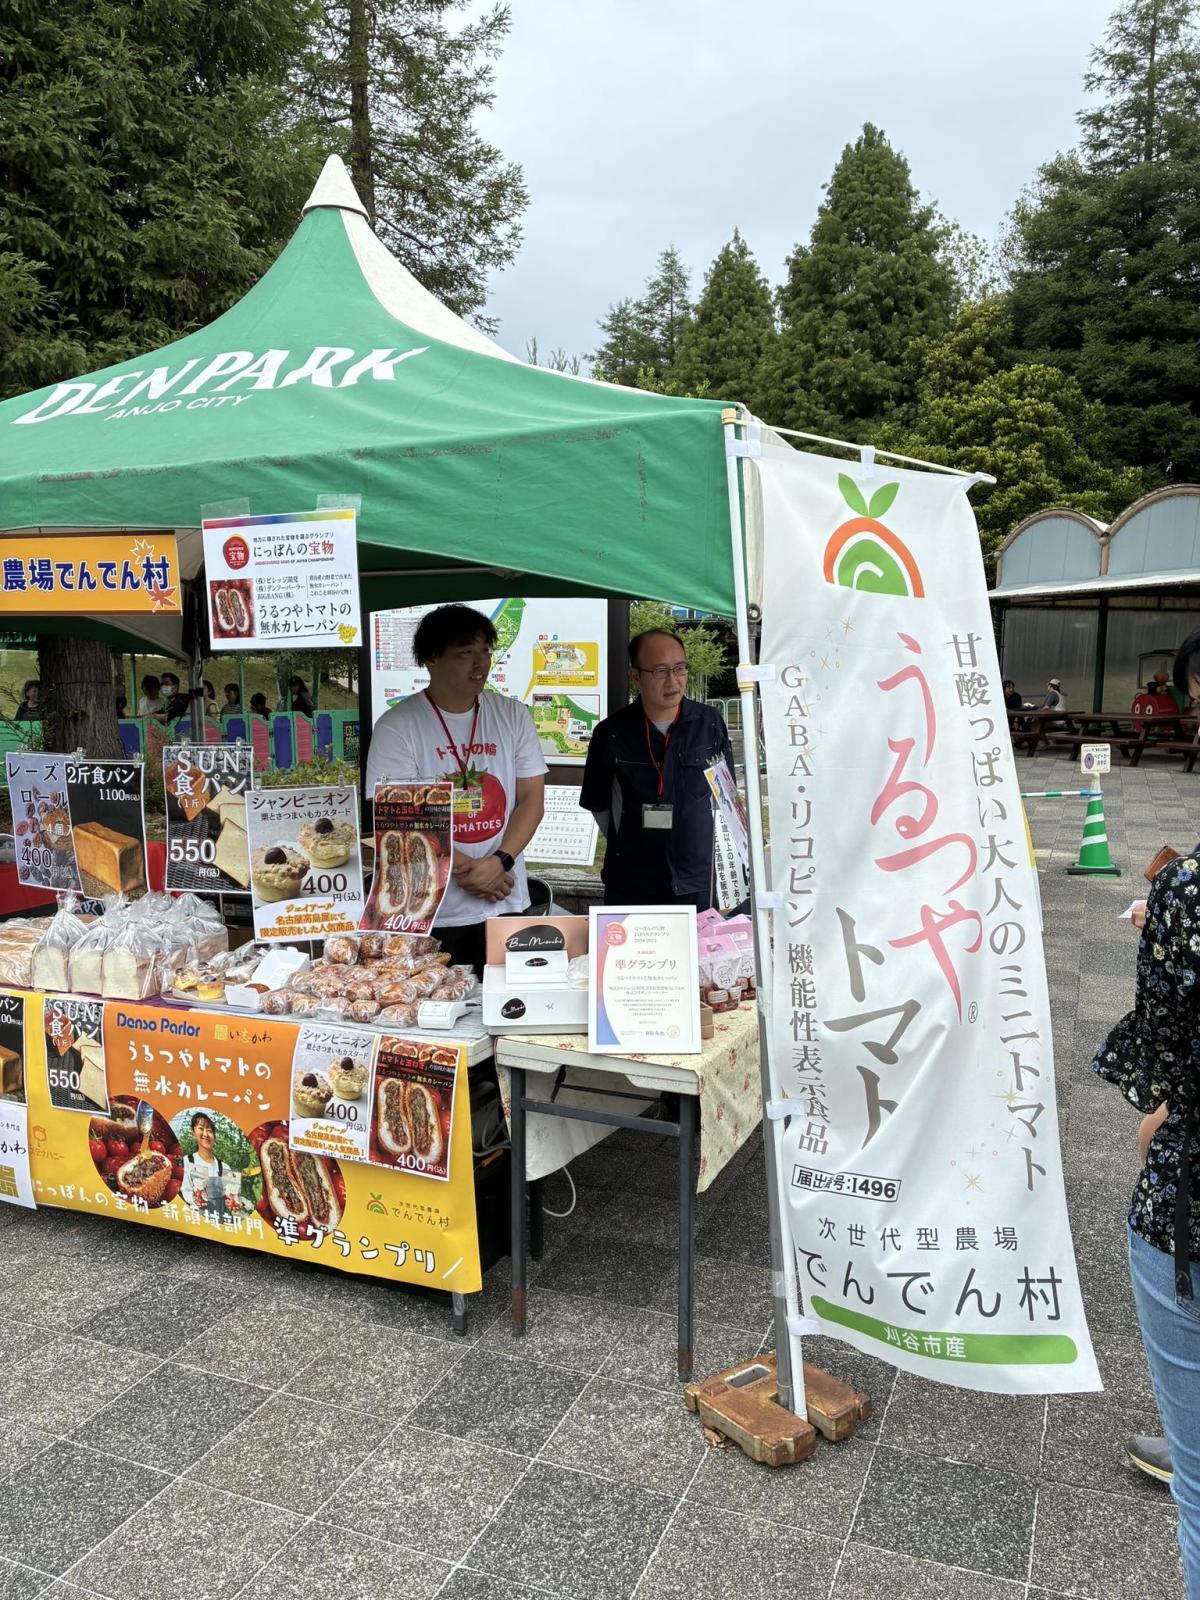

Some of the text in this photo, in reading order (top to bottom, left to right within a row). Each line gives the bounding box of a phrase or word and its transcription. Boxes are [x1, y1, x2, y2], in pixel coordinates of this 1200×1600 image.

[10, 346, 431, 424] DENPARK
[104, 393, 255, 421] ANJO CITY
[253, 540, 334, 557] にっぽんの宝物
[0, 556, 170, 591] 農場でんでん村
[259, 602, 352, 619] うるつやトマトの
[260, 619, 339, 634] 無水カレーパン
[176, 750, 241, 773] SUN
[436, 742, 497, 760] トマトの輪
[67, 766, 135, 784] 2斤食パン
[174, 774, 247, 797] 食パン
[21, 790, 68, 808] ロール
[251, 792, 350, 811] シャンピニオン
[261, 807, 351, 822] 栗とさつまいもカスタード
[869, 631, 983, 1026] うるつや
[21, 847, 52, 868] 400
[170, 838, 216, 863] 550
[302, 873, 348, 895] 400
[332, 891, 361, 902] 円(込)
[946, 632, 1047, 1191] 甘酸っぱい大人のミニトマト
[615, 959, 677, 971] 準グランプリ
[53, 1000, 97, 1022] SUN
[49, 1018, 99, 1038] 食パン
[116, 1012, 157, 1031] Denso
[160, 1018, 201, 1037] Parlor
[823, 906, 922, 1150] トマト
[303, 1029, 371, 1049] シャンピニオン
[786, 942, 831, 1156] 機能性表示食品
[128, 1040, 271, 1080] うるつやトマトの
[49, 1069, 80, 1090] 550
[133, 1069, 271, 1110] 無水カレーパン
[325, 1102, 358, 1121] 400
[31, 1180, 149, 1215] にっぽんの宝物
[161, 1199, 264, 1239] 新領域部門
[392, 1207, 449, 1227] でんでん村
[273, 1215, 436, 1273] 準グランプリ
[818, 1217, 1019, 1251] 次世代型農場
[799, 1247, 1063, 1321] でんでん村
[883, 1325, 967, 1358] 刈谷市産
